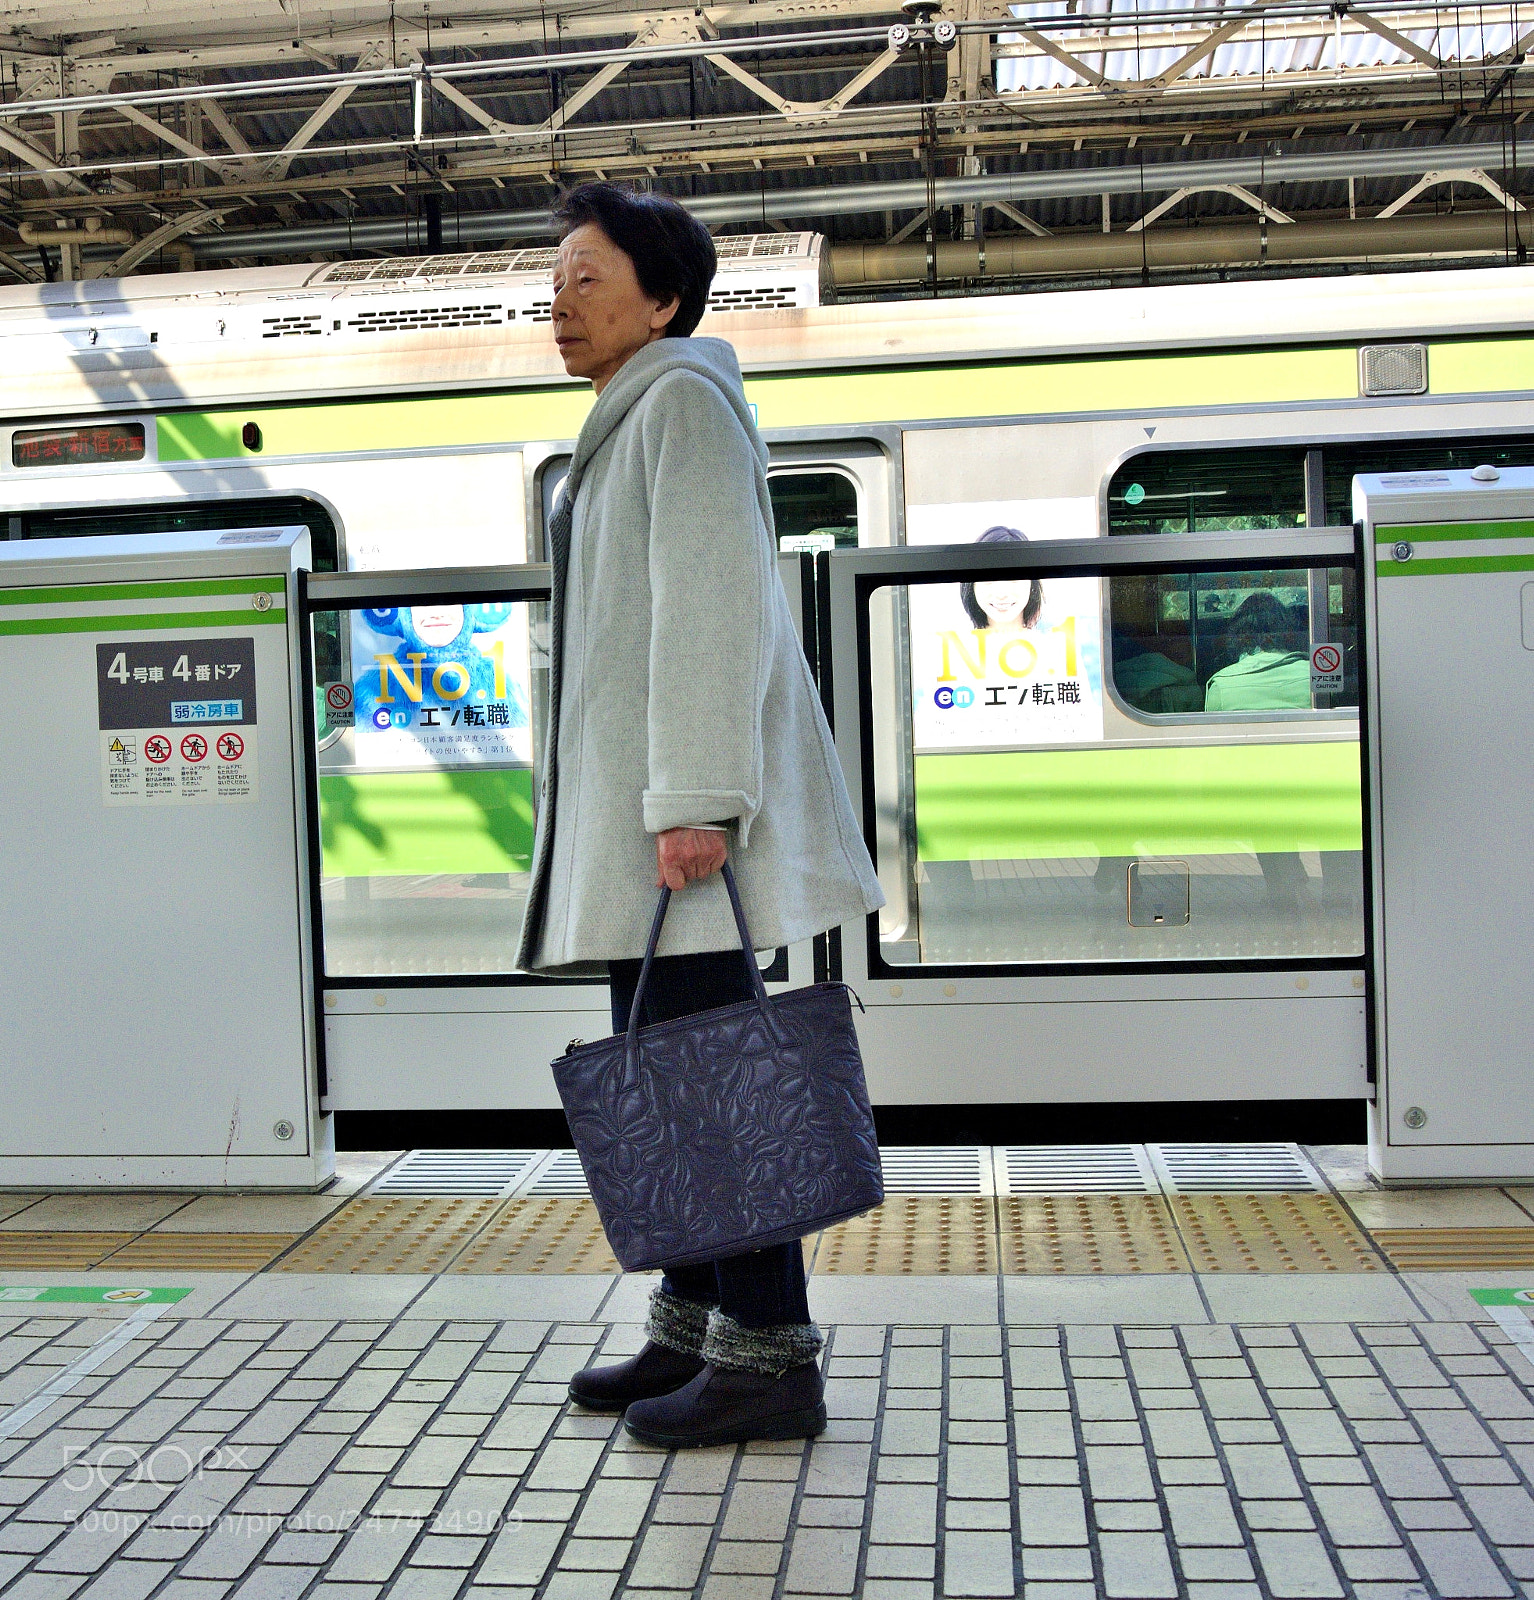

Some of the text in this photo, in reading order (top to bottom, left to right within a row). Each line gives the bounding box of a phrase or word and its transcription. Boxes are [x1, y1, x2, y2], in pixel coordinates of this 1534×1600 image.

[936, 616, 1078, 682] No.1
[107, 652, 242, 685] 4号車 4番ドア
[373, 641, 507, 704] No.1
[934, 681, 1082, 709] en エン転職
[174, 703, 239, 720] 弱冷房車
[373, 703, 510, 729] en エン転職
